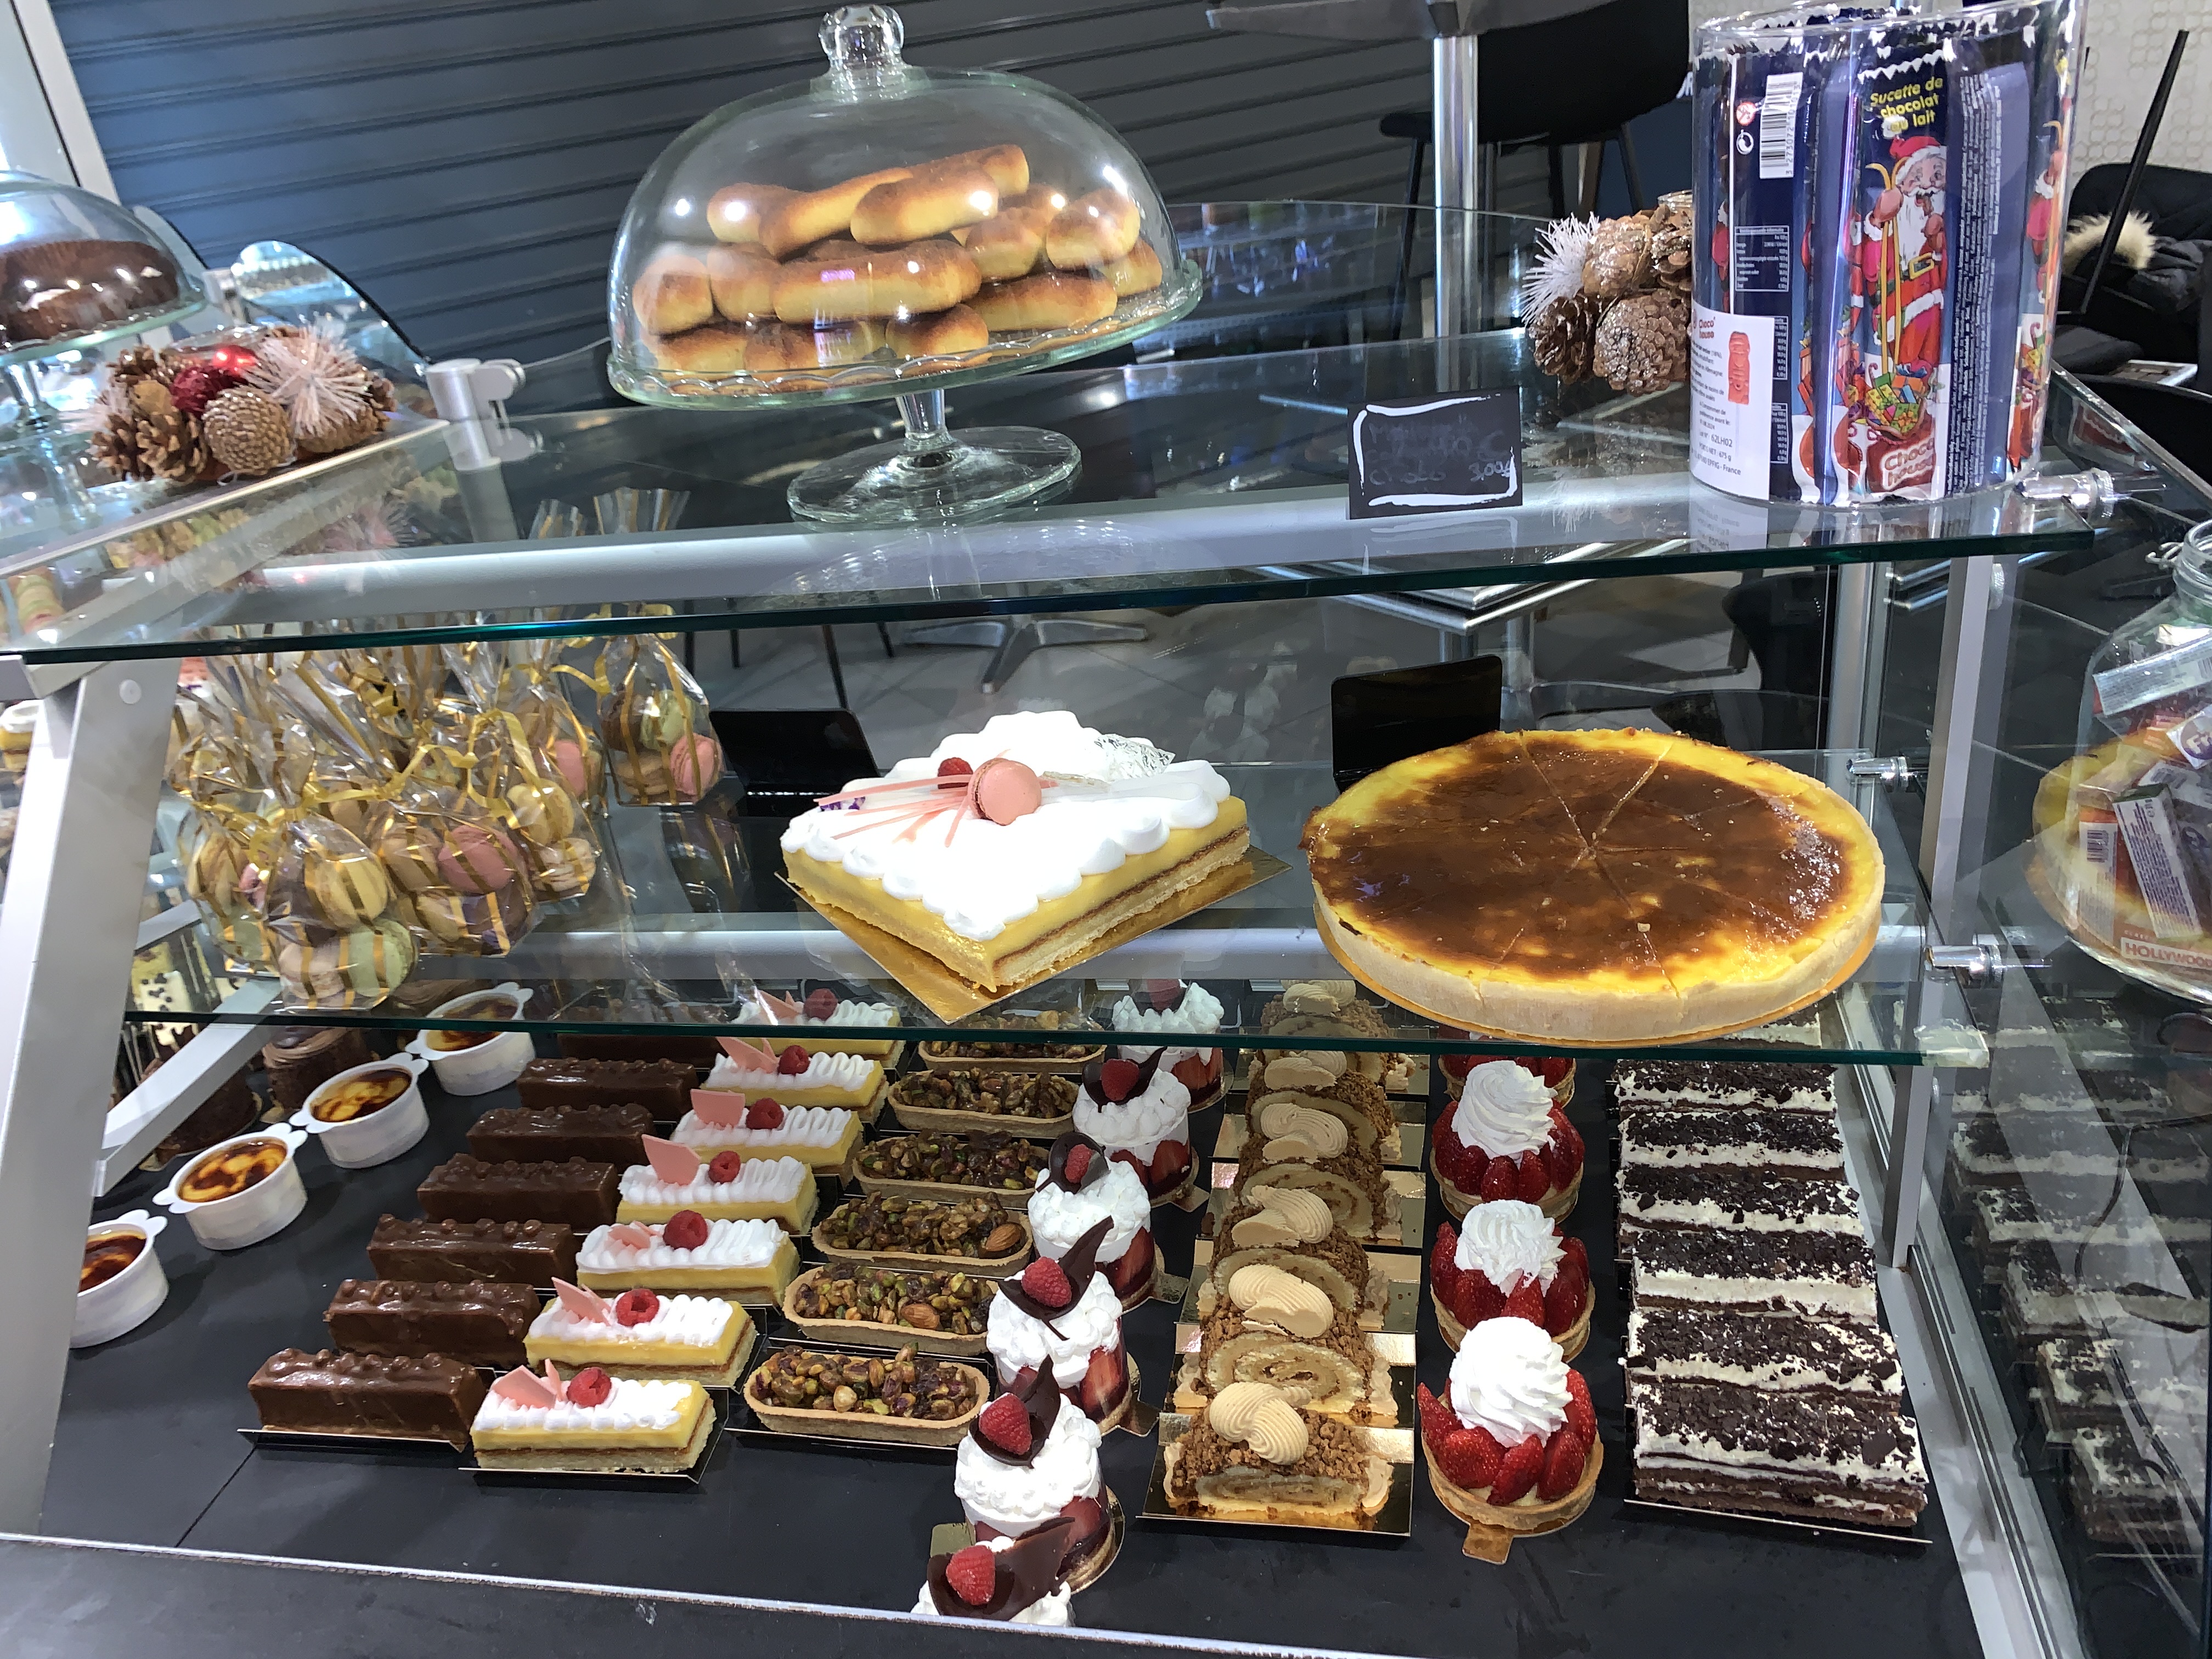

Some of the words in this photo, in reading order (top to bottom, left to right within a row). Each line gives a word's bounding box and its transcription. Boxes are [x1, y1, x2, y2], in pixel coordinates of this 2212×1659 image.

[1870, 84, 1921, 105] Sucette
[1925, 76, 1943, 91] de
[1880, 92, 1939, 118] chocolat
[1912, 109, 1936, 127] lait
[1723, 464, 1741, 476] France
